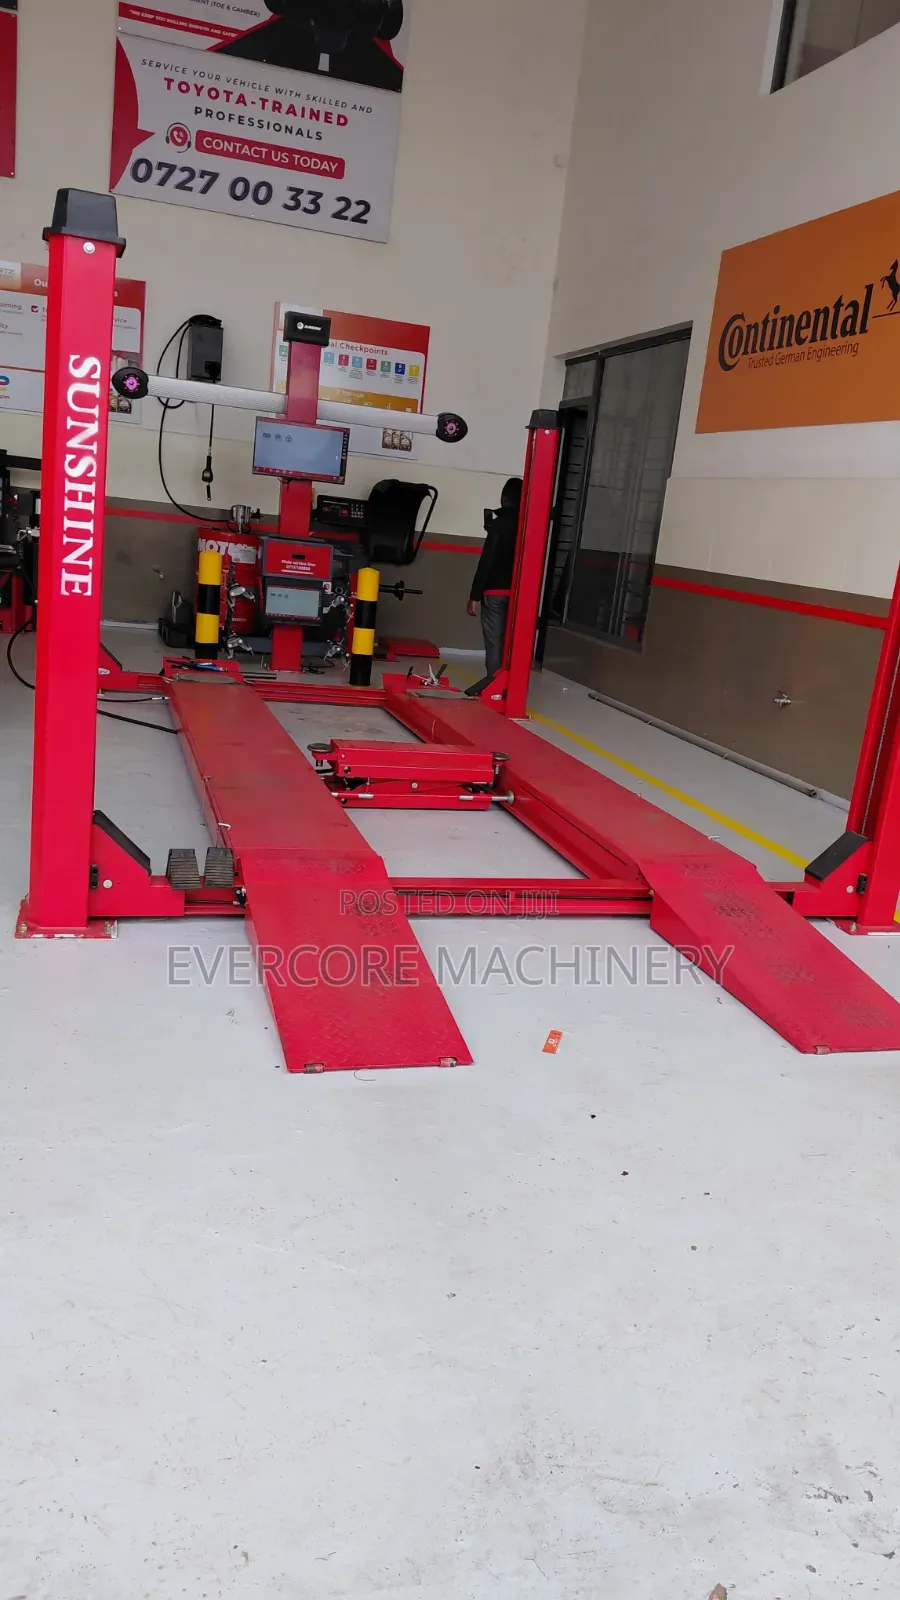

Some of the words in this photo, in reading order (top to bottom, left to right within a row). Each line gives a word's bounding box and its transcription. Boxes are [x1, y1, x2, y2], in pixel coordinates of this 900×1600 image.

[141, 58, 188, 75] SERVICE
[192, 70, 221, 82] YOUR
[225, 77, 270, 92] VEHICLE
[275, 87, 301, 99] WITH
[305, 94, 348, 109] SKILLED
[351, 103, 373, 114] AND
[164, 77, 349, 127] TOYOTA-TRAINED
[194, 106, 323, 141] PROFESSIONALS
[203, 137, 268, 159] CONTACT
[271, 151, 290, 163] US
[292, 154, 338, 173] TODAY
[130, 157, 219, 195] 0727
[228, 176, 273, 205] 00
[282, 186, 324, 215] 33
[330, 196, 372, 224] 22
[339, 342, 388, 356] Checkpoints
[718, 283, 874, 372] Continental
[748, 355, 773, 369] Trusted
[775, 352, 805, 365] German
[807, 341, 859, 362] Engineering
[60, 354, 101, 597] SUNSHINE
